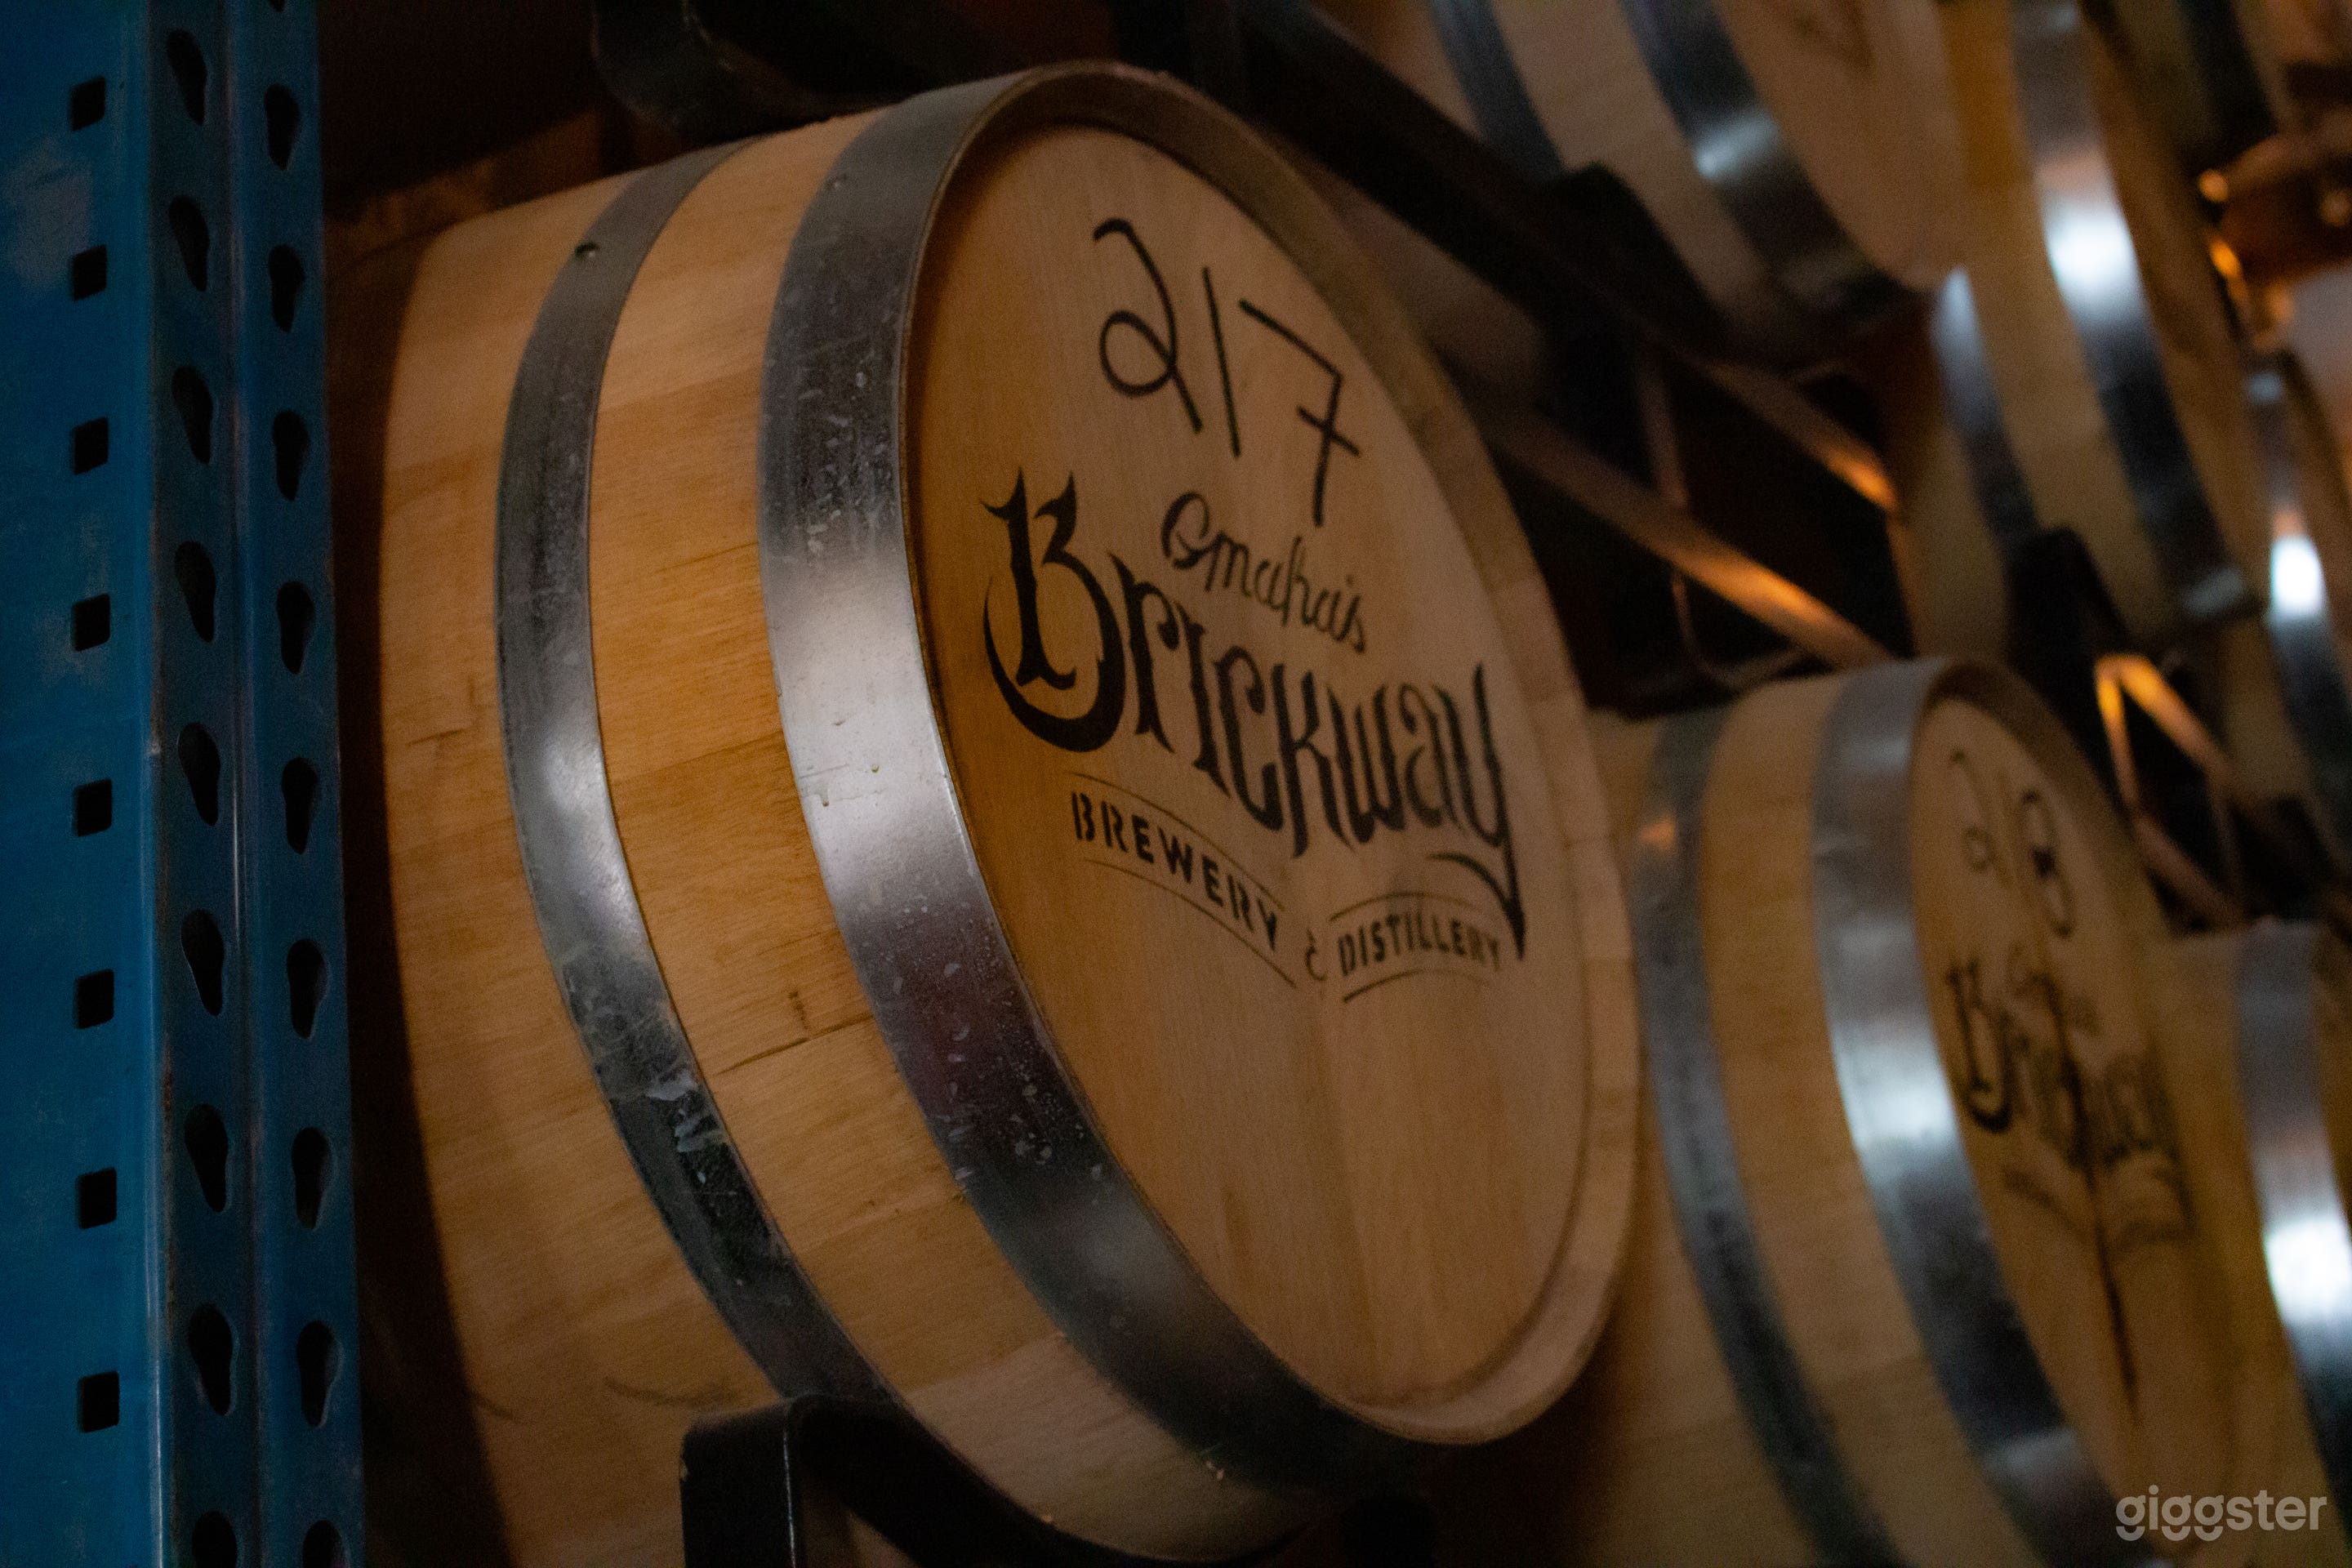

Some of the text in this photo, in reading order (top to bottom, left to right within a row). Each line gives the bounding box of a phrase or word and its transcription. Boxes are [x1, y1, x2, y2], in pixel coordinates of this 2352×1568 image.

[1093, 216, 1361, 528] 2/7
[980, 466, 1526, 962] Brickway
[1070, 791, 1279, 951] BREWERY
[1337, 908, 1502, 977] DISTILLERY
